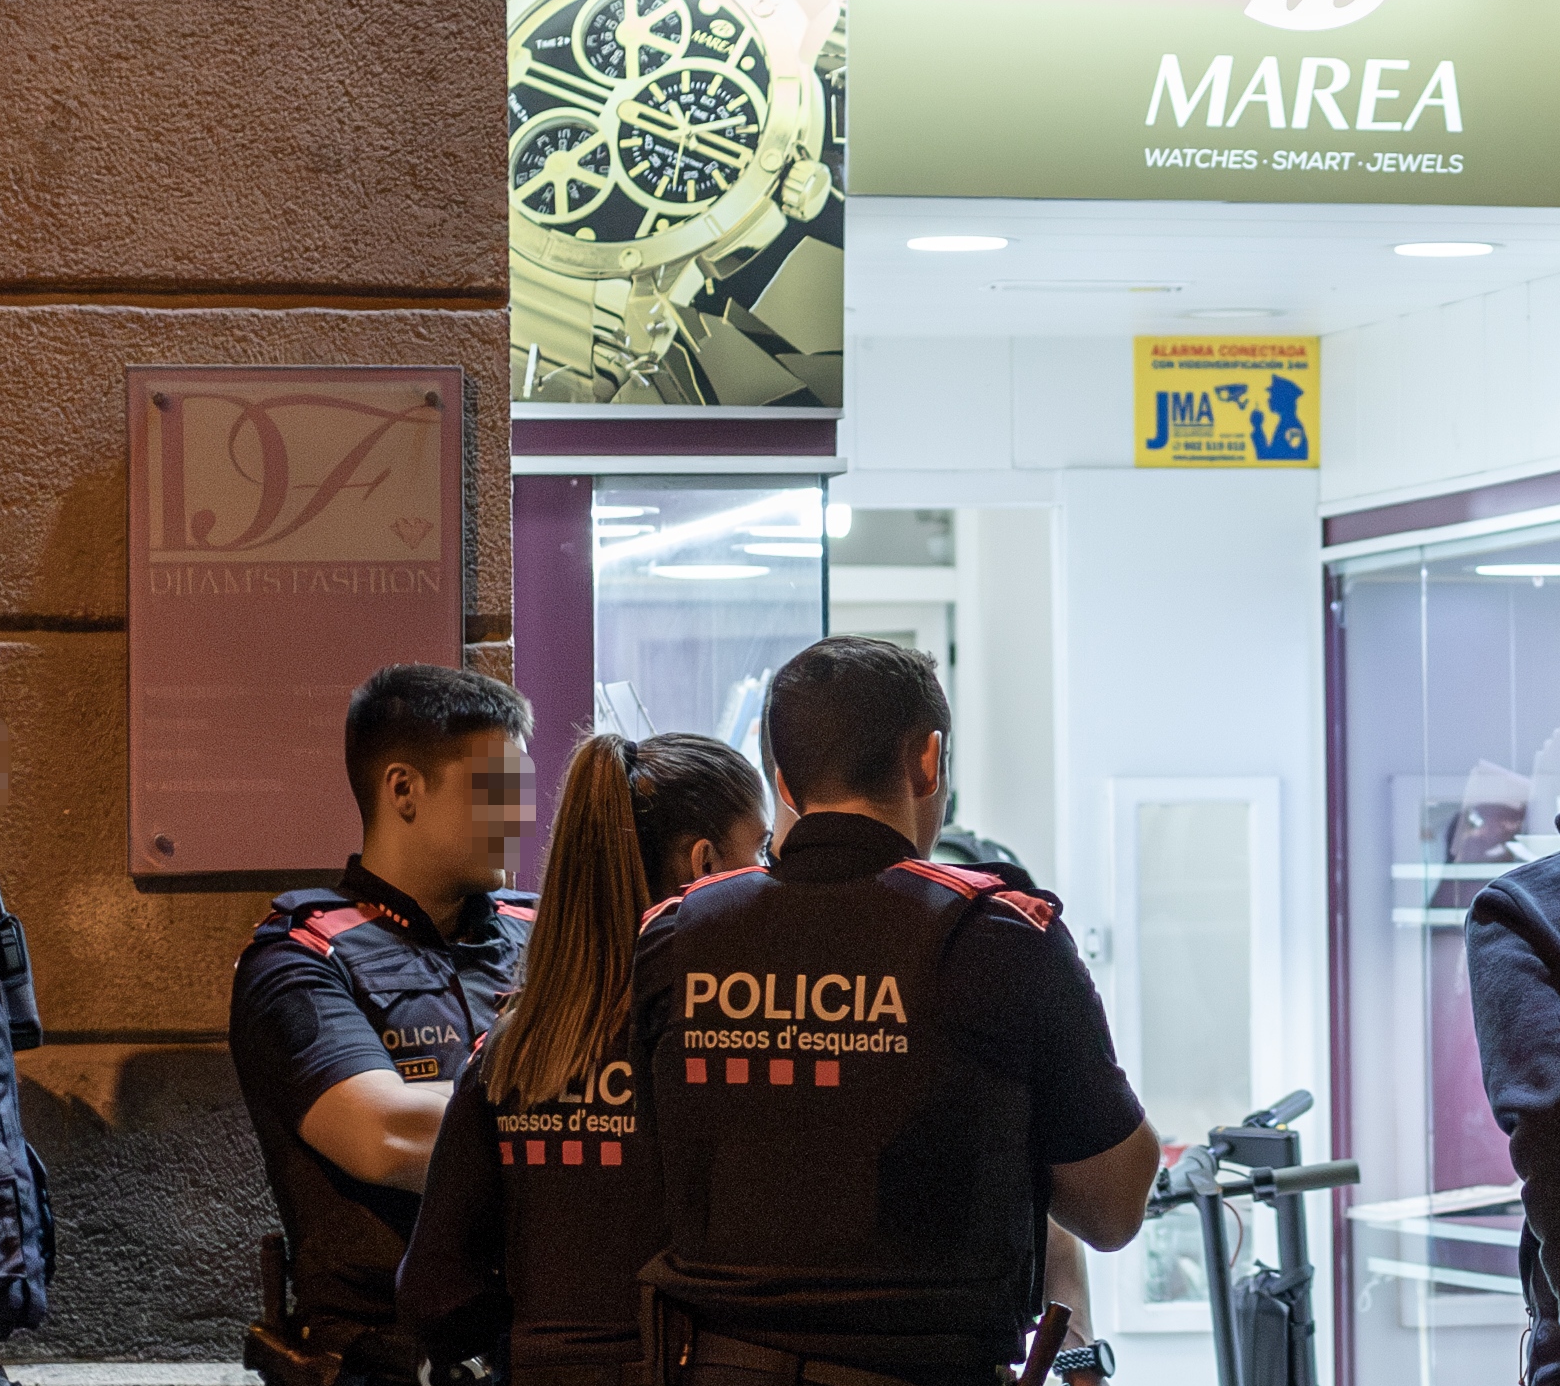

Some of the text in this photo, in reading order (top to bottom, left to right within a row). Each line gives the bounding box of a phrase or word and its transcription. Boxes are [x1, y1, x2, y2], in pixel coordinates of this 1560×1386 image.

[690, 29, 737, 56] MAREA
[1145, 53, 1464, 133] MAREA
[1144, 148, 1465, 174] WATCHES SMART JEWELS
[1151, 345, 1307, 357] ALARMA CONECTADA
[1152, 360, 1175, 369] CON
[1146, 391, 1214, 450] JMA
[291, 567, 440, 596] FASHION
[685, 971, 908, 1024] POLICIA
[684, 1025, 909, 1056] mossos d'esquadra
[497, 1113, 563, 1132] mossos
